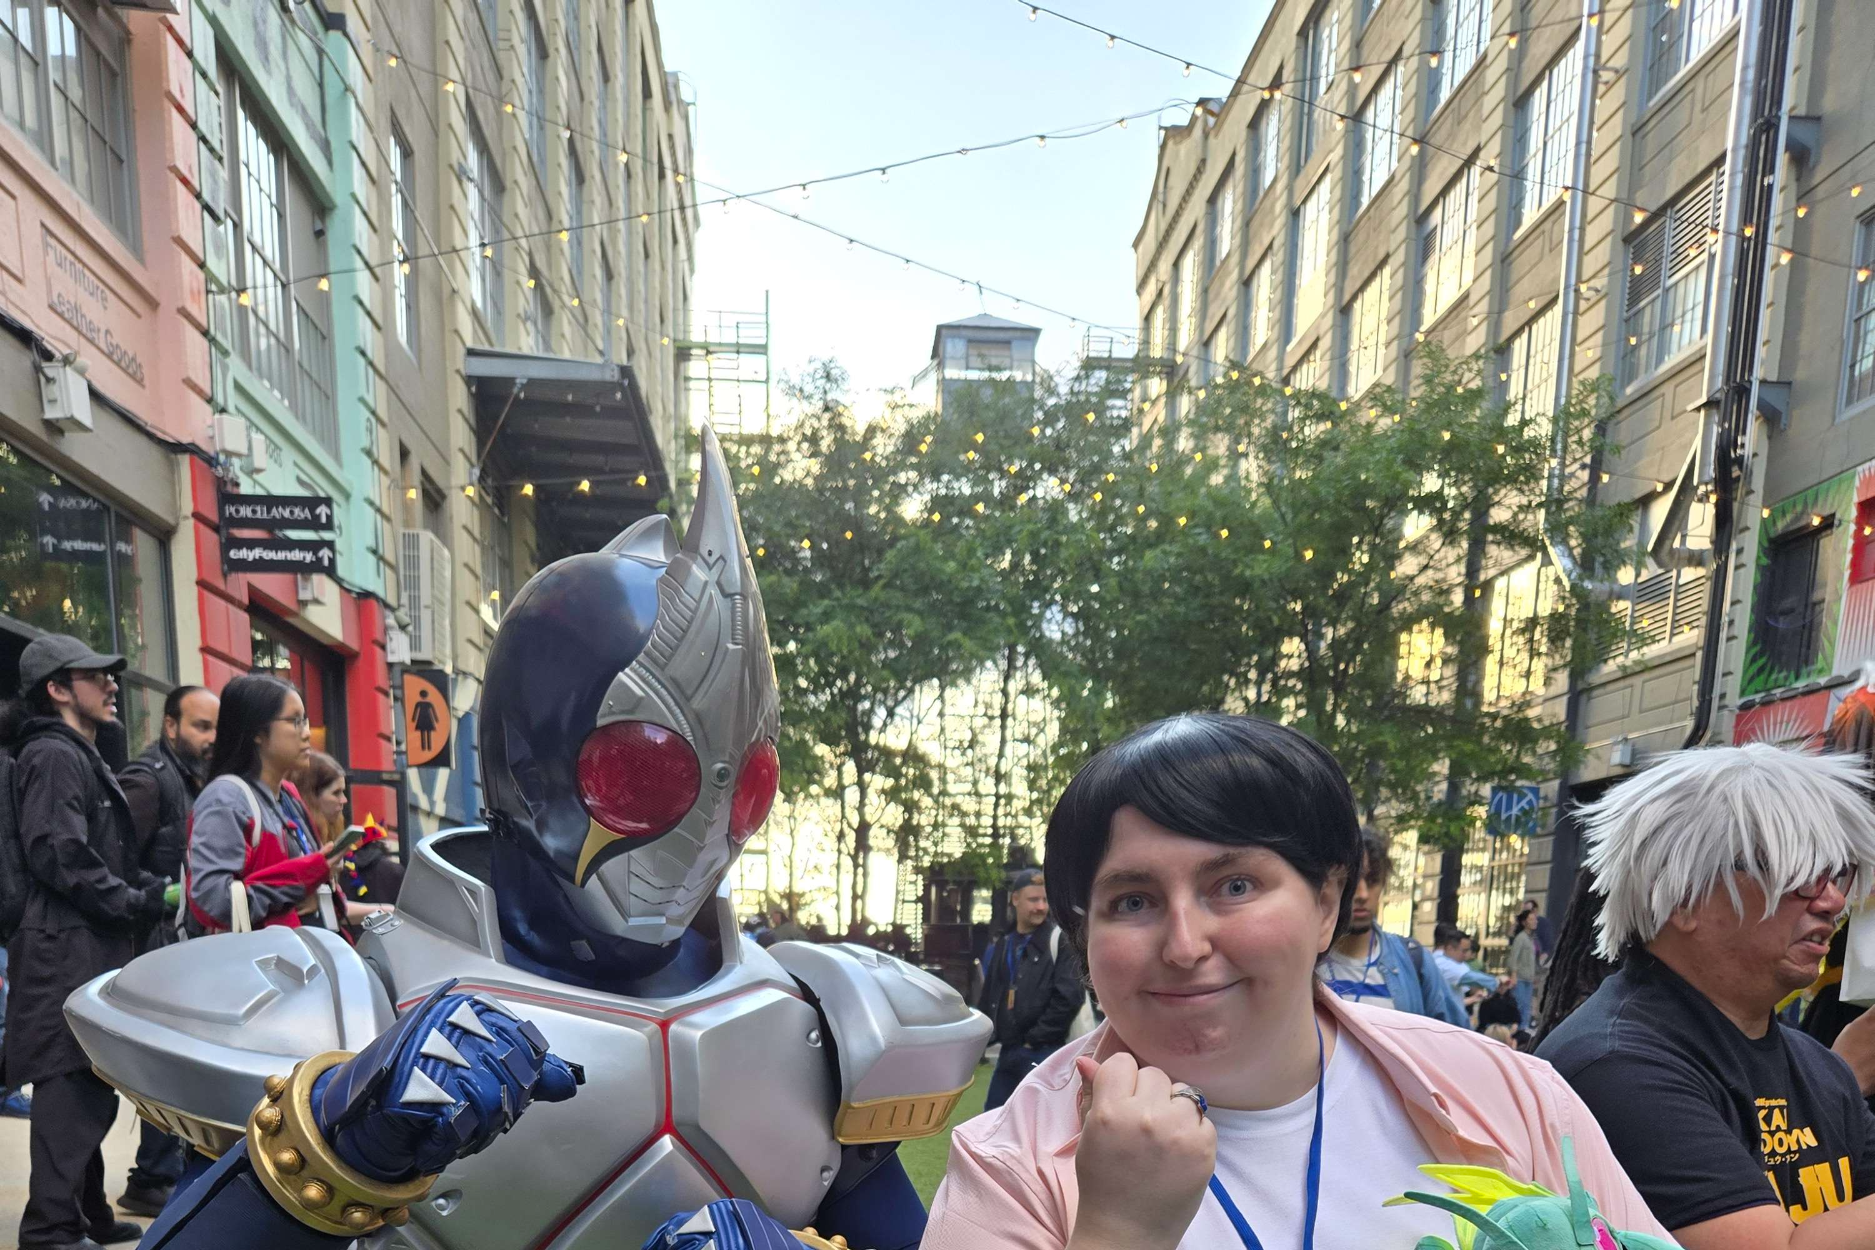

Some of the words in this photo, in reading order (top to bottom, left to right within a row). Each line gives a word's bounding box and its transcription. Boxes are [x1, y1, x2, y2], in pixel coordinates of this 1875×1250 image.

[43, 229, 109, 311] Furniture
[49, 277, 101, 344] Leather
[104, 328, 145, 382] Goods
[225, 503, 312, 520] PORCELANOSA
